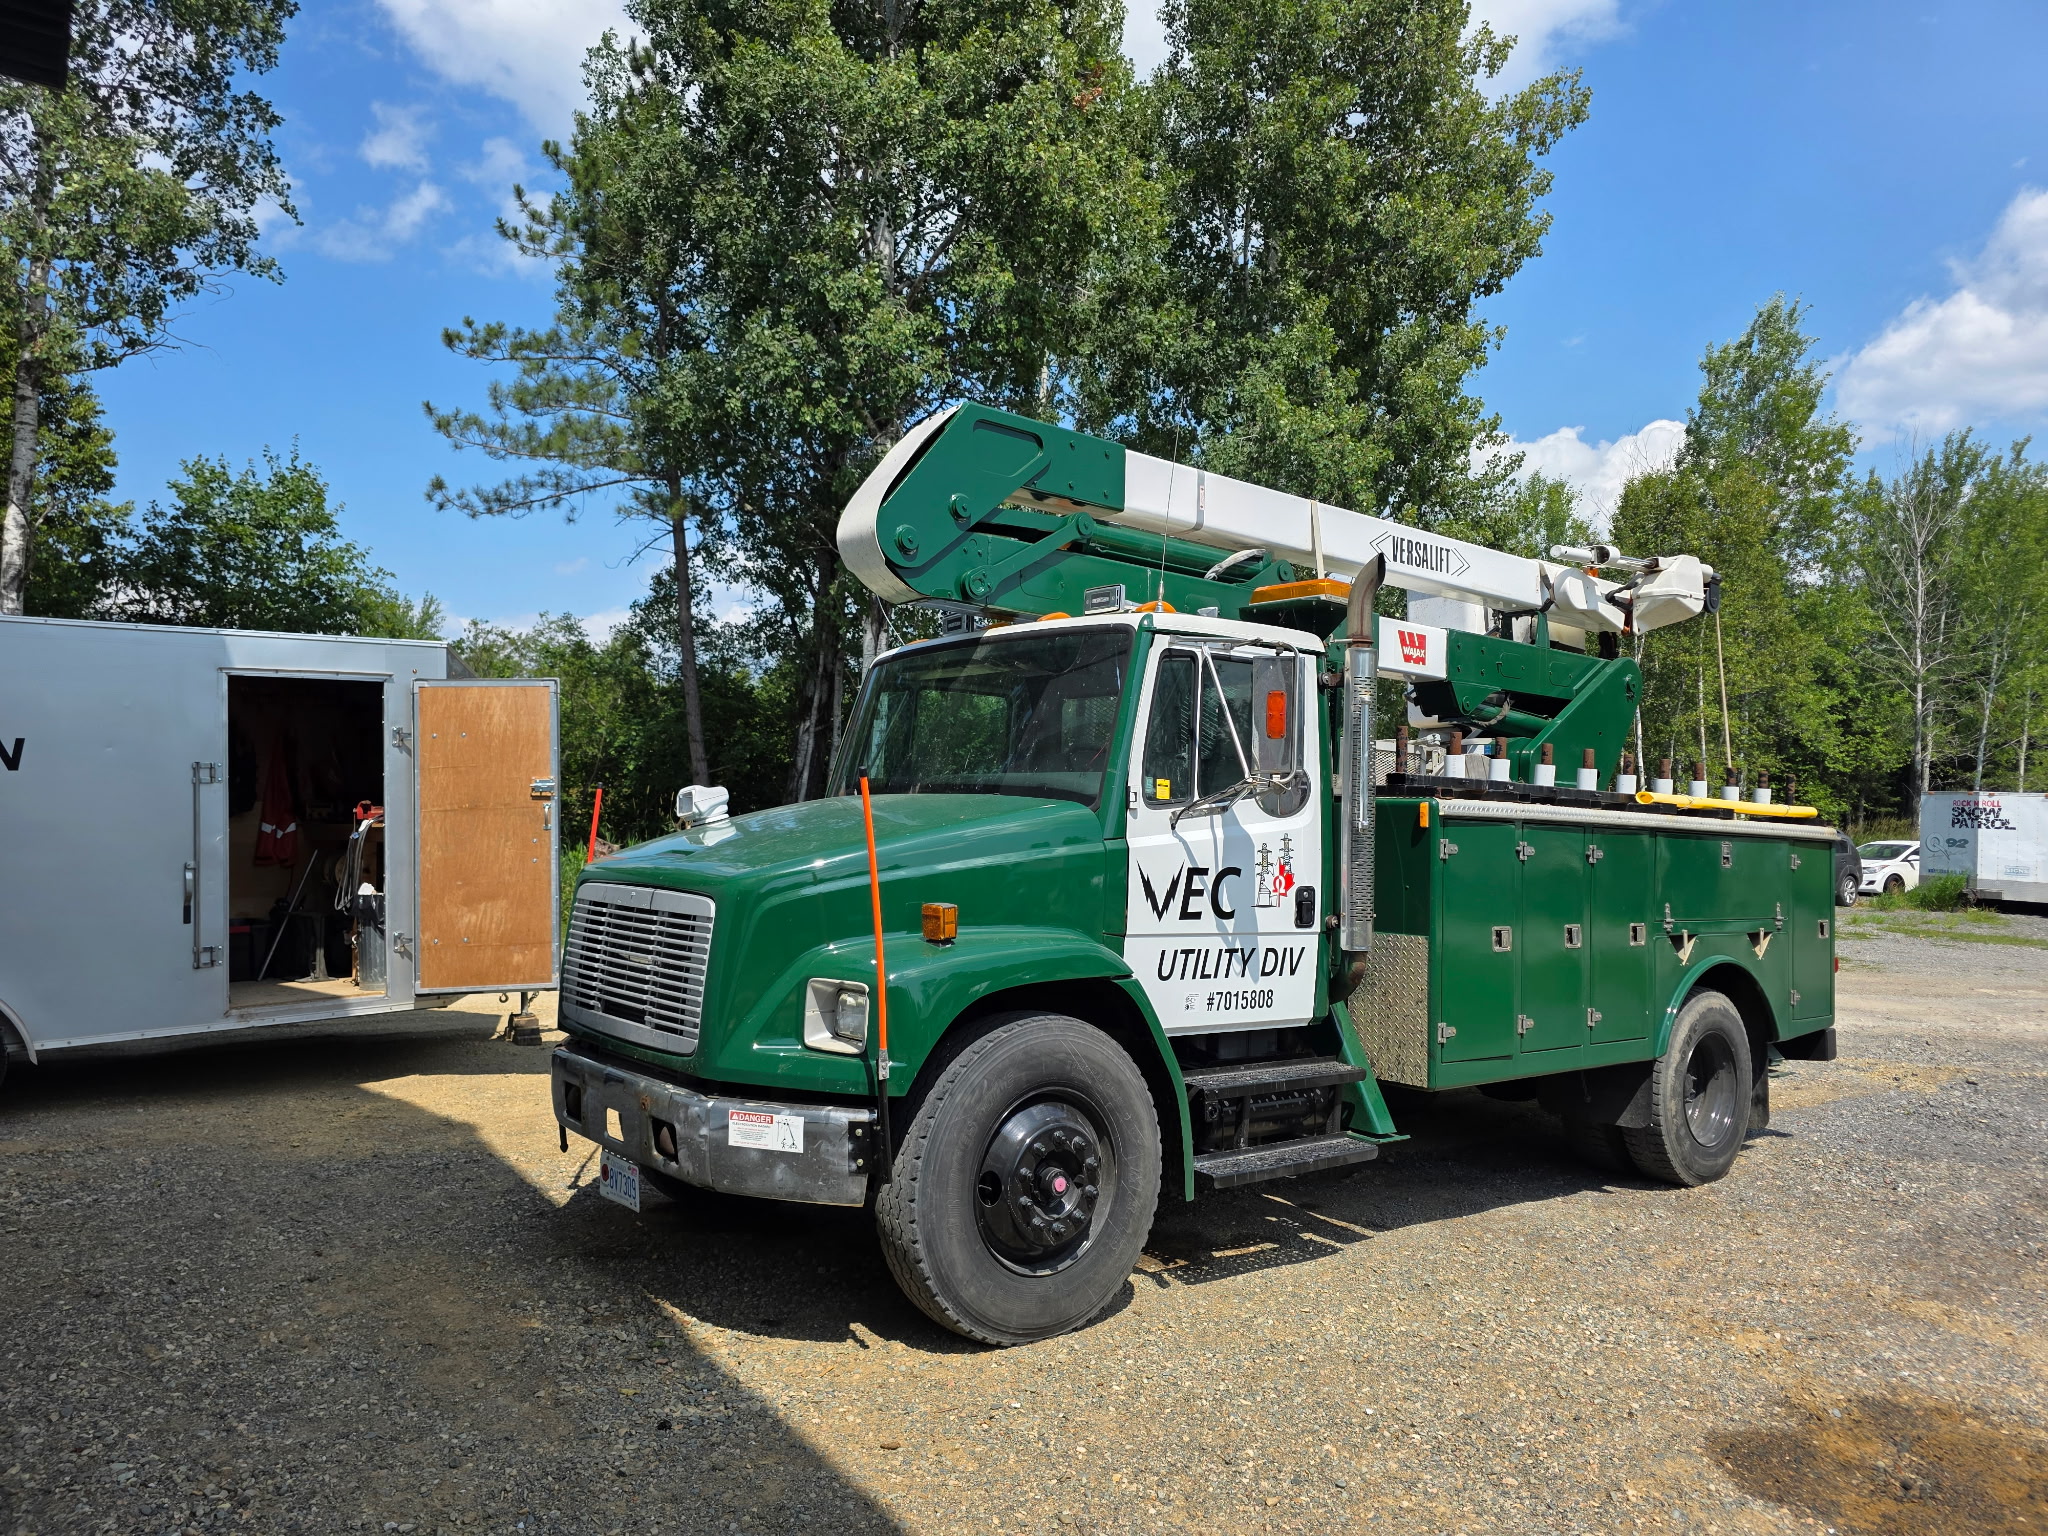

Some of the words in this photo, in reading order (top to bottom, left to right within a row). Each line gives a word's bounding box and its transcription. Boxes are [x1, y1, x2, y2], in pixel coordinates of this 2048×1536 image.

[1392, 535, 1450, 574] VERSALIFT
[1403, 645, 1425, 659] WAJAX
[1952, 799, 1971, 807] ROCK
[1981, 799, 2001, 807] ROLL
[1951, 807, 2002, 819] SNOW
[1951, 817, 2016, 830] PATROL
[1945, 837, 1969, 849] 92
[1136, 858, 1242, 923] VEC
[1157, 947, 1257, 981] UTILITY
[1260, 946, 1306, 977] DIV
[1206, 988, 1274, 1012] #7015808
[739, 1113, 772, 1124] DANGER
